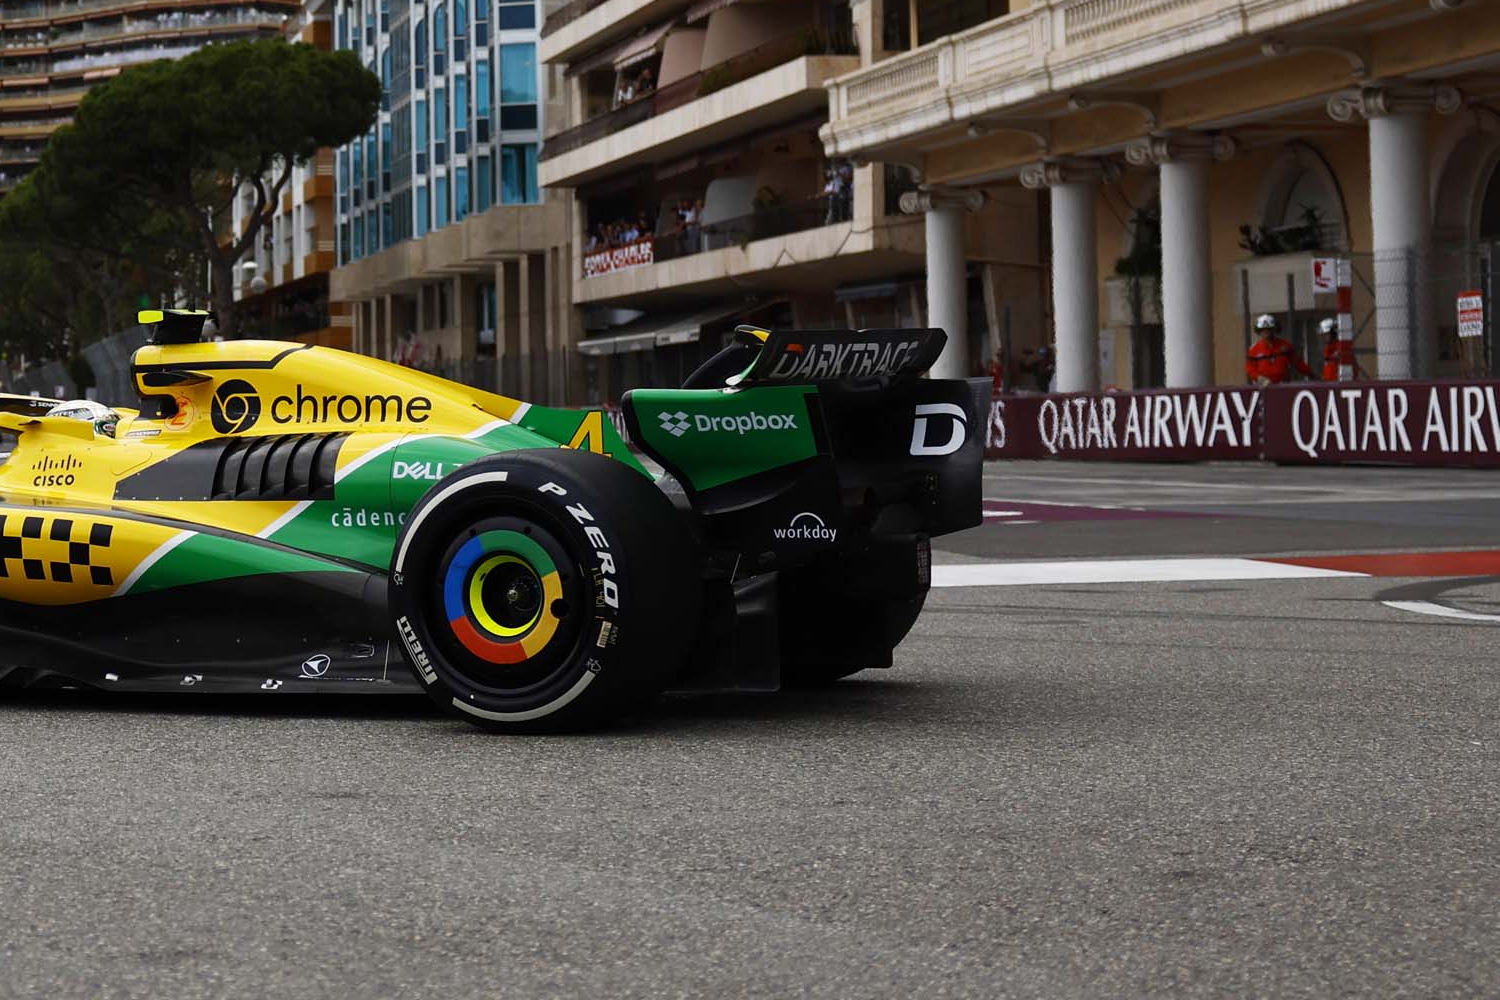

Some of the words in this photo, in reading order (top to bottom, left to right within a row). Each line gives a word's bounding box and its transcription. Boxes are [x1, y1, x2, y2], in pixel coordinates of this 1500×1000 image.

[271, 384, 432, 424] chrome
[694, 412, 797, 434] Dropbox
[1037, 398, 1117, 453] QATAR
[1291, 389, 1412, 458] QATAR
[560, 411, 612, 457] 4
[393, 461, 443, 480] DELL
[538, 482, 567, 496] P
[565, 502, 619, 609] ZERO
[773, 525, 837, 542] workday
[396, 616, 438, 685] PIRELLI
